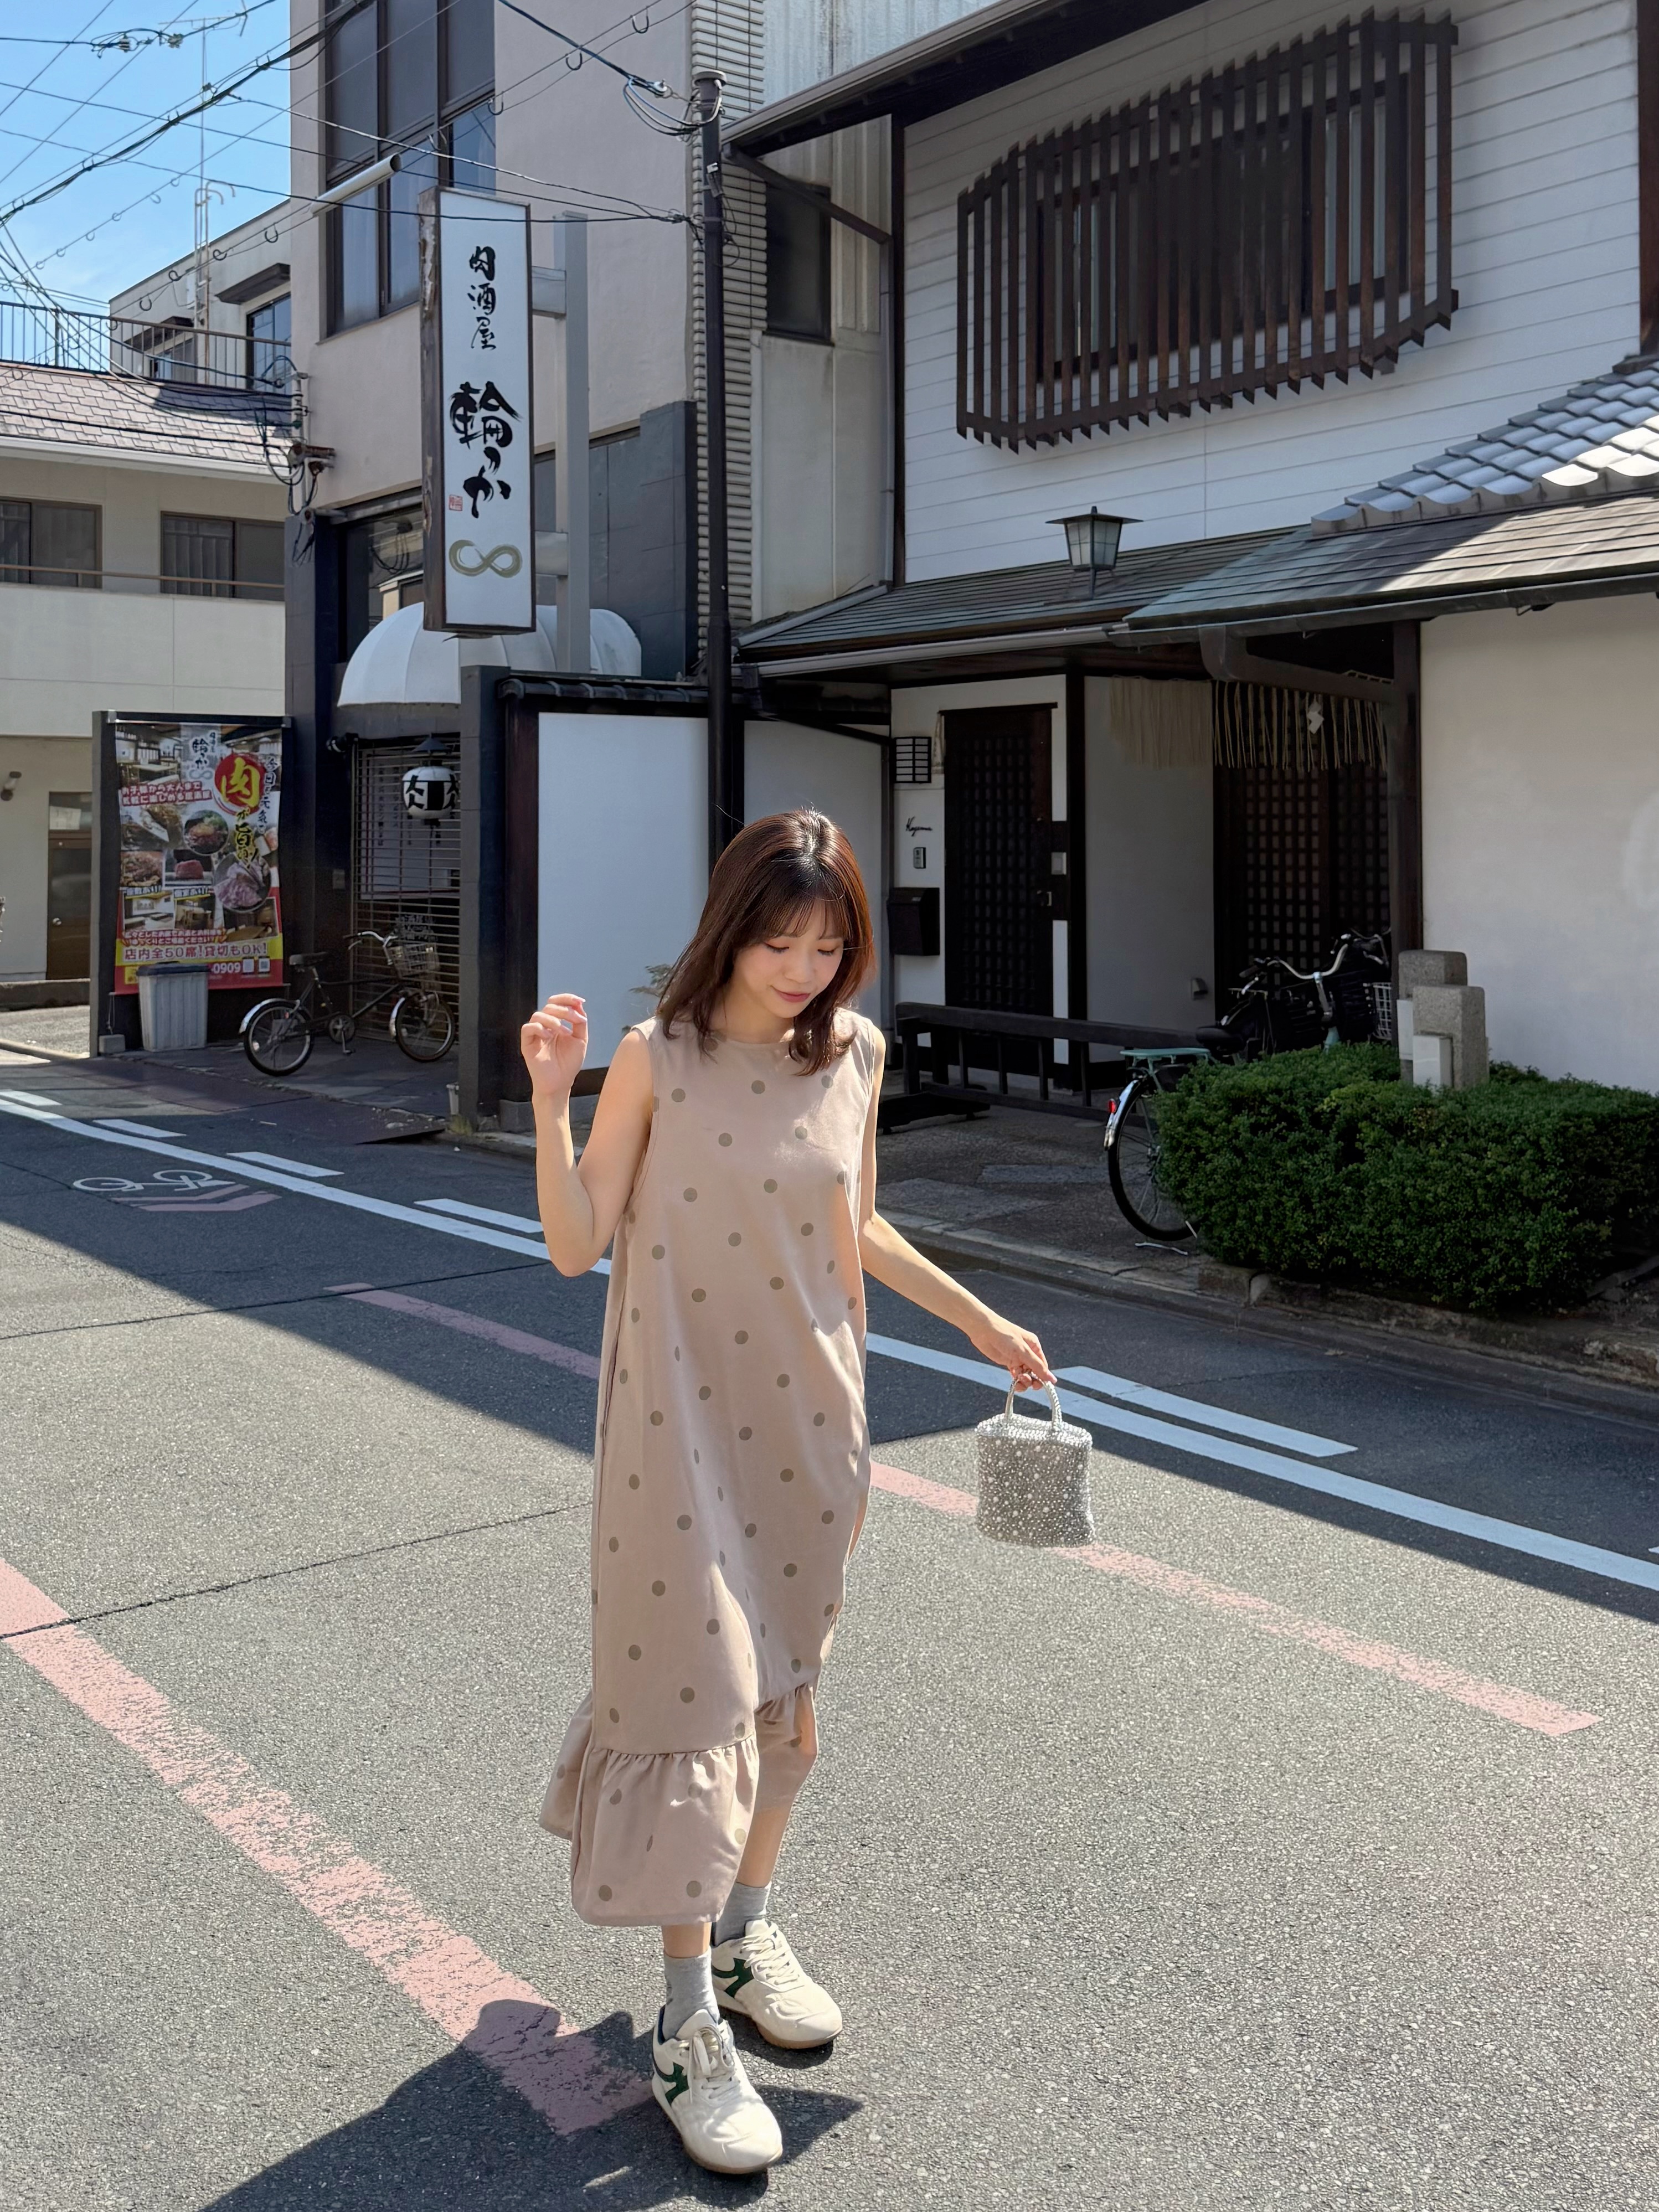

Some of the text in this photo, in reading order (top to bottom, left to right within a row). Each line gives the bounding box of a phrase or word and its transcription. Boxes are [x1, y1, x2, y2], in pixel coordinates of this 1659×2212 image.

[467, 246, 497, 350] 肉酒屋
[221, 756, 260, 808] 肉
